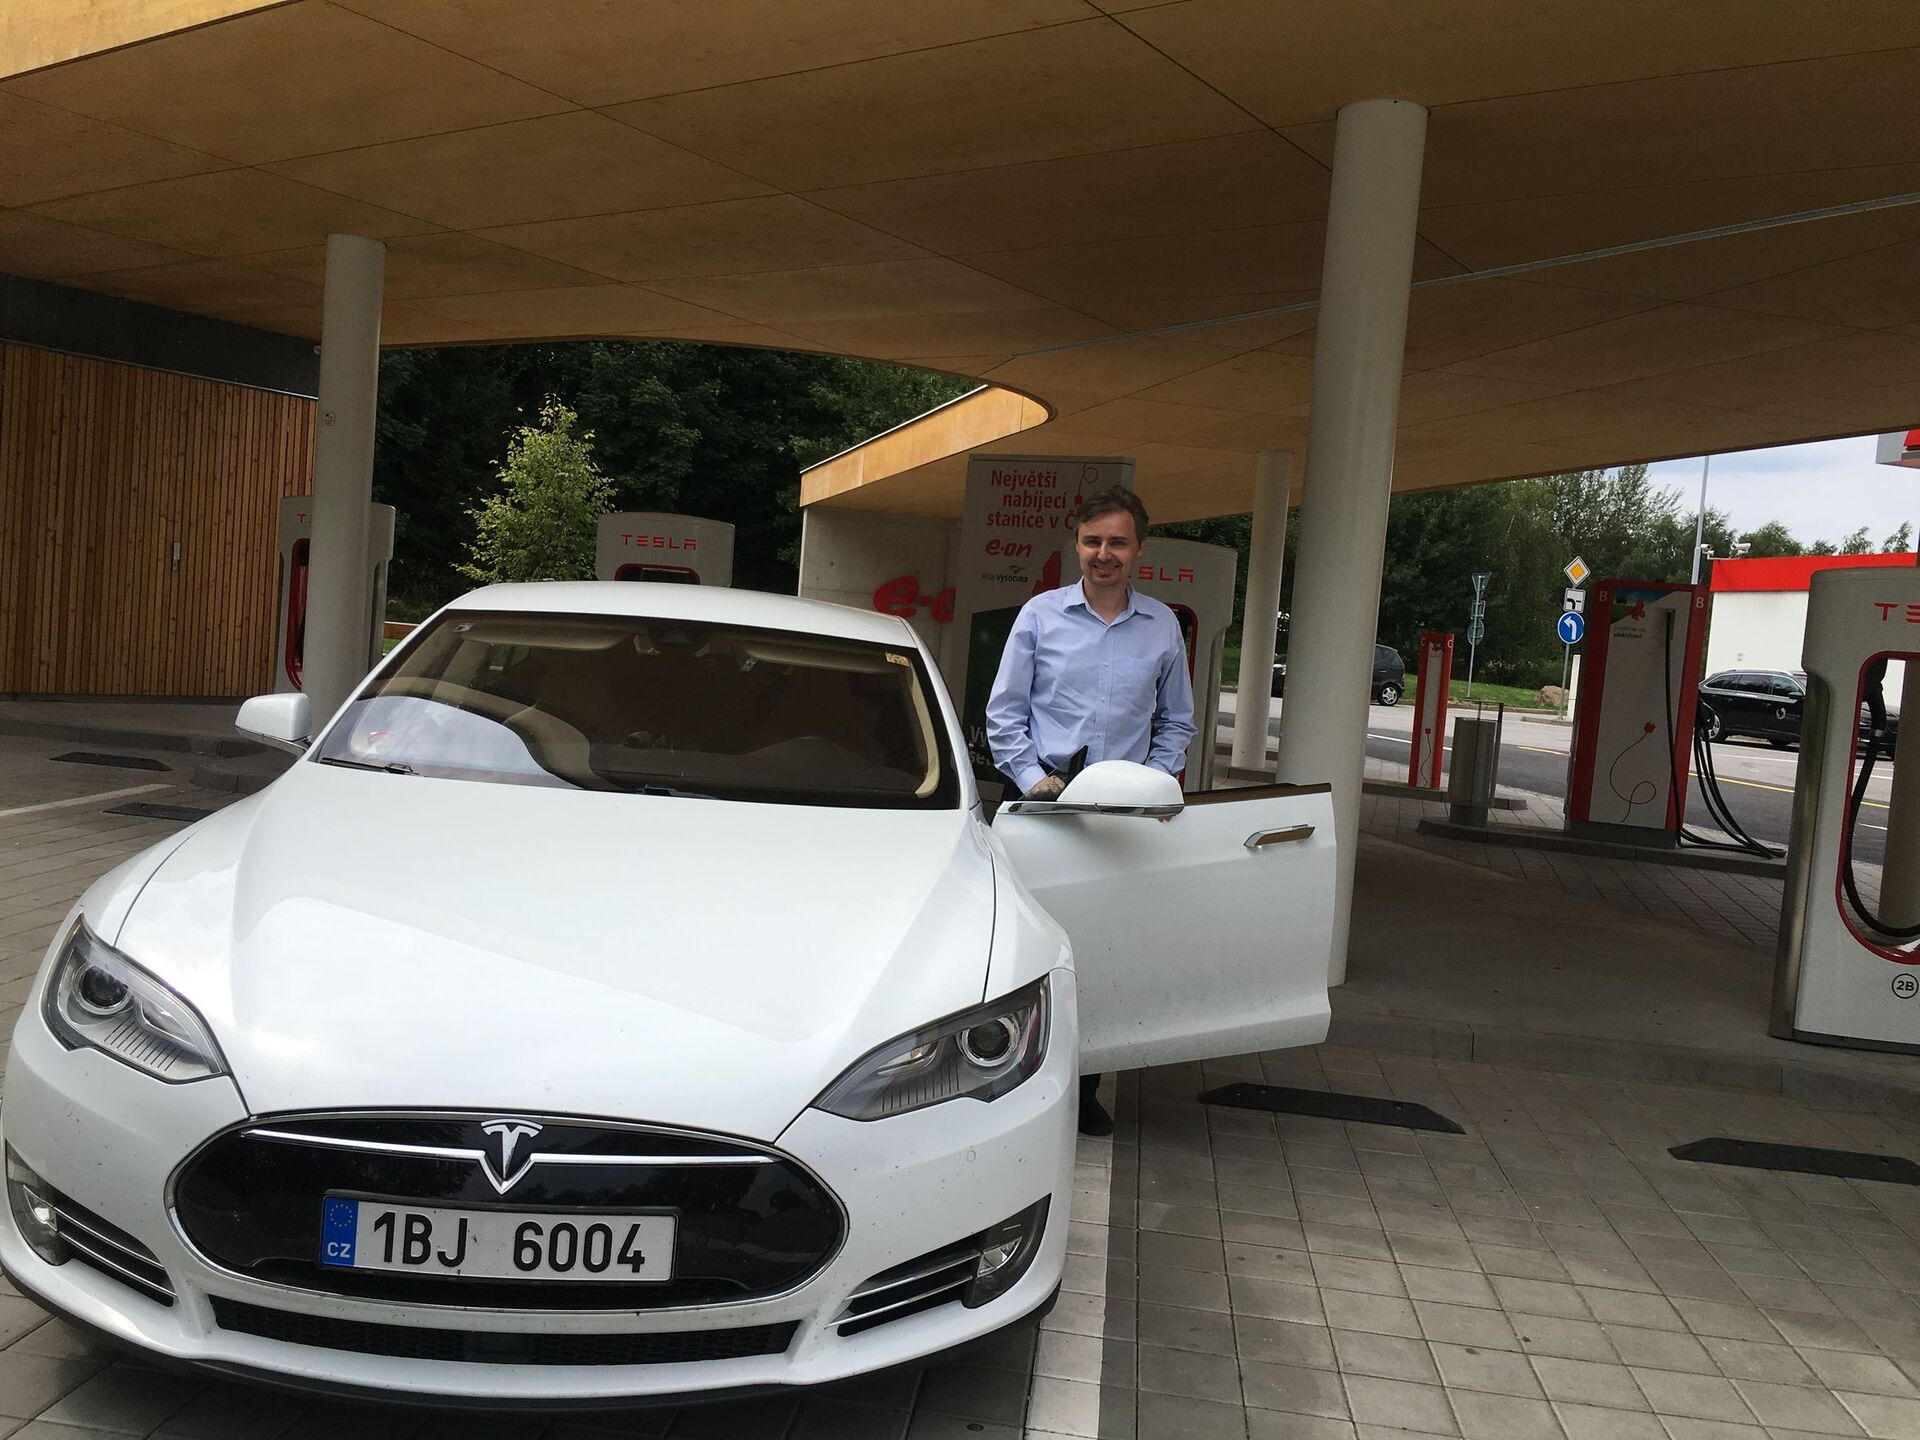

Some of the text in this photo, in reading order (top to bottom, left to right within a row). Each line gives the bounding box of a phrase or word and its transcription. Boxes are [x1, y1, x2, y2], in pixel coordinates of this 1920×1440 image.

[991, 470, 1058, 491] Největší
[1003, 490, 1068, 512] nabíjecí
[987, 510, 1077, 530] stanice v Č
[621, 534, 697, 551] TESLA
[1138, 566, 1194, 583] SLA
[1600, 590, 1608, 601] B
[1696, 597, 1704, 608] B
[1896, 980, 1914, 991] 2B
[327, 1211, 645, 1273] CZ 1BJ 6004
